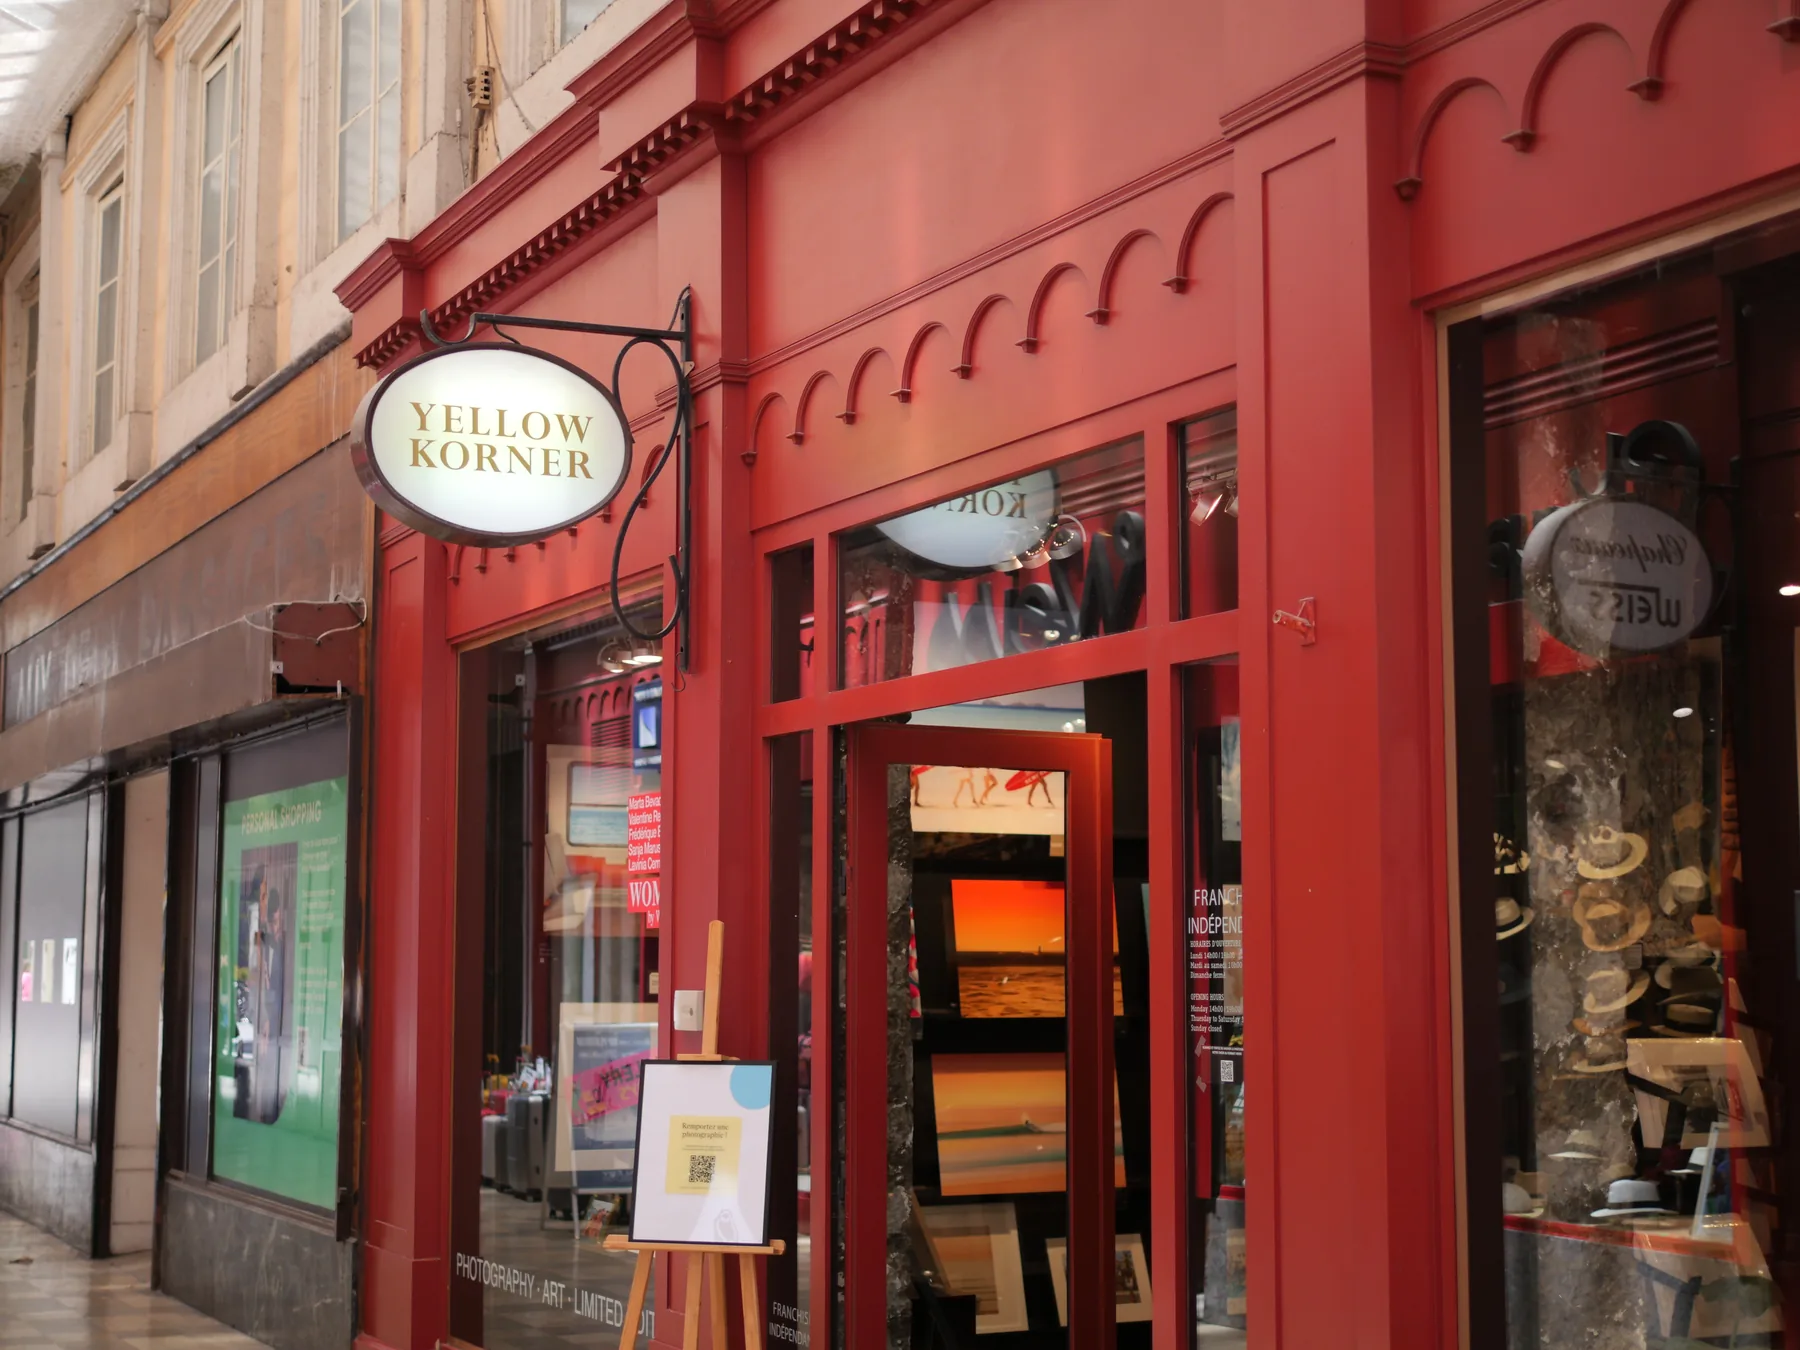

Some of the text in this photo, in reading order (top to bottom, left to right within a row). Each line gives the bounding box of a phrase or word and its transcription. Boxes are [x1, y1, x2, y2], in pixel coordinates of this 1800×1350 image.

[409, 402, 594, 443] YELLOW
[409, 438, 594, 479] KORNER
[629, 797, 645, 809] Marta
[241, 800, 322, 836] PERSONAL SHOPPING
[629, 812, 653, 826] Valentine
[629, 826, 657, 842] Frédérique
[628, 843, 644, 857] Sanja
[628, 858, 647, 871] Lavinia
[1194, 888, 1243, 906] FRANCH
[1190, 961, 1203, 969] Mardi
[1190, 971, 1212, 979] Dimanche
[1190, 993, 1225, 1001] OPENING HOURS
[1190, 1005, 1208, 1014] Monday
[1190, 1024, 1207, 1033] Sunday
[682, 1122, 716, 1131] Remportez
[681, 1131, 724, 1140] photographie
[456, 1252, 535, 1299] PHOTOGRAPHY
[541, 1279, 565, 1309] ART
[574, 1288, 623, 1327] LIMITED
